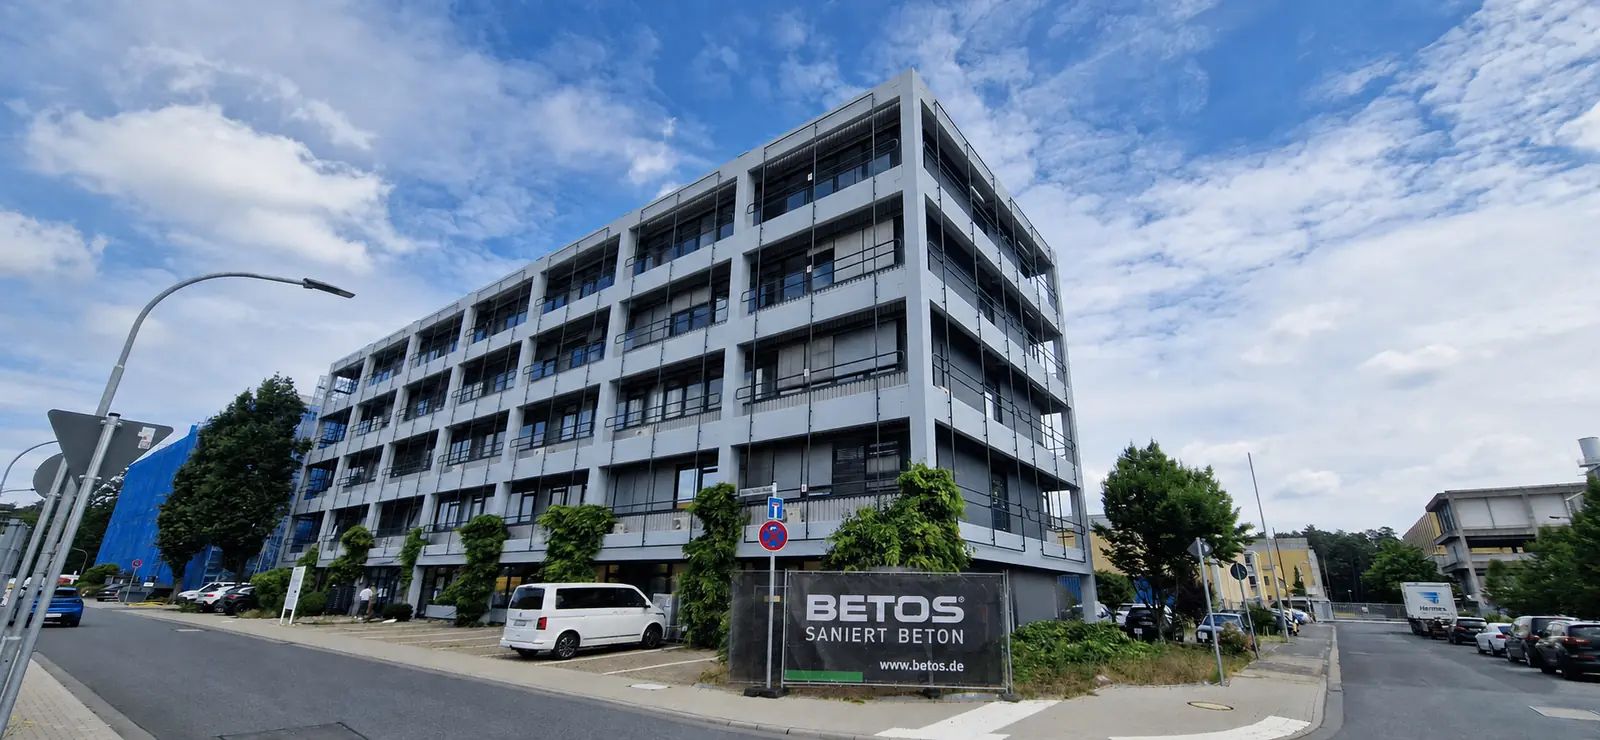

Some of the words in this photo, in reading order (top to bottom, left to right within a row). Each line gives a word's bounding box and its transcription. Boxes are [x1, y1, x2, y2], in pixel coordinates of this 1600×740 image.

[805, 626, 888, 644] SANIERT
[898, 628, 964, 645] BETON
[879, 659, 965, 672] www.betos.de
